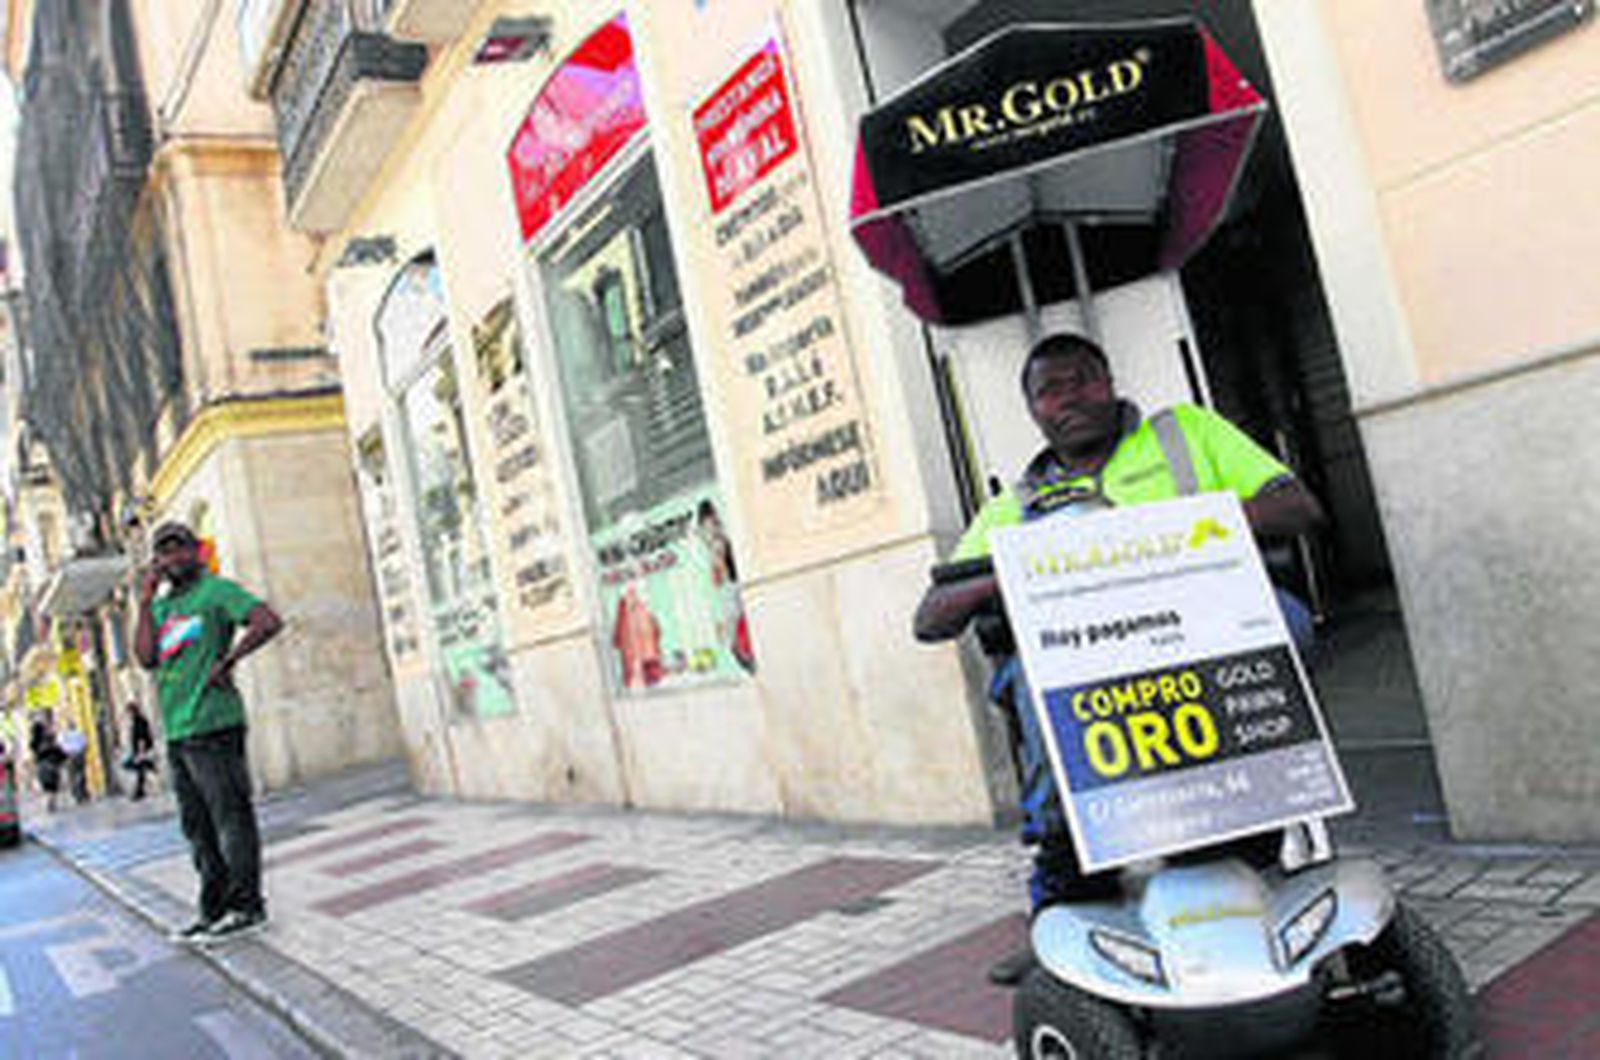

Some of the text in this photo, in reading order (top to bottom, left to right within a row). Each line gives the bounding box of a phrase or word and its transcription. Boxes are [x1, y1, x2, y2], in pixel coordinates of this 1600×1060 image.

[1088, 609, 1182, 645] pagamos
[1216, 661, 1276, 689] GOLD
[1071, 670, 1202, 722] COMPRO
[1082, 702, 1219, 778] ORO
[1232, 715, 1293, 744] SHOP
